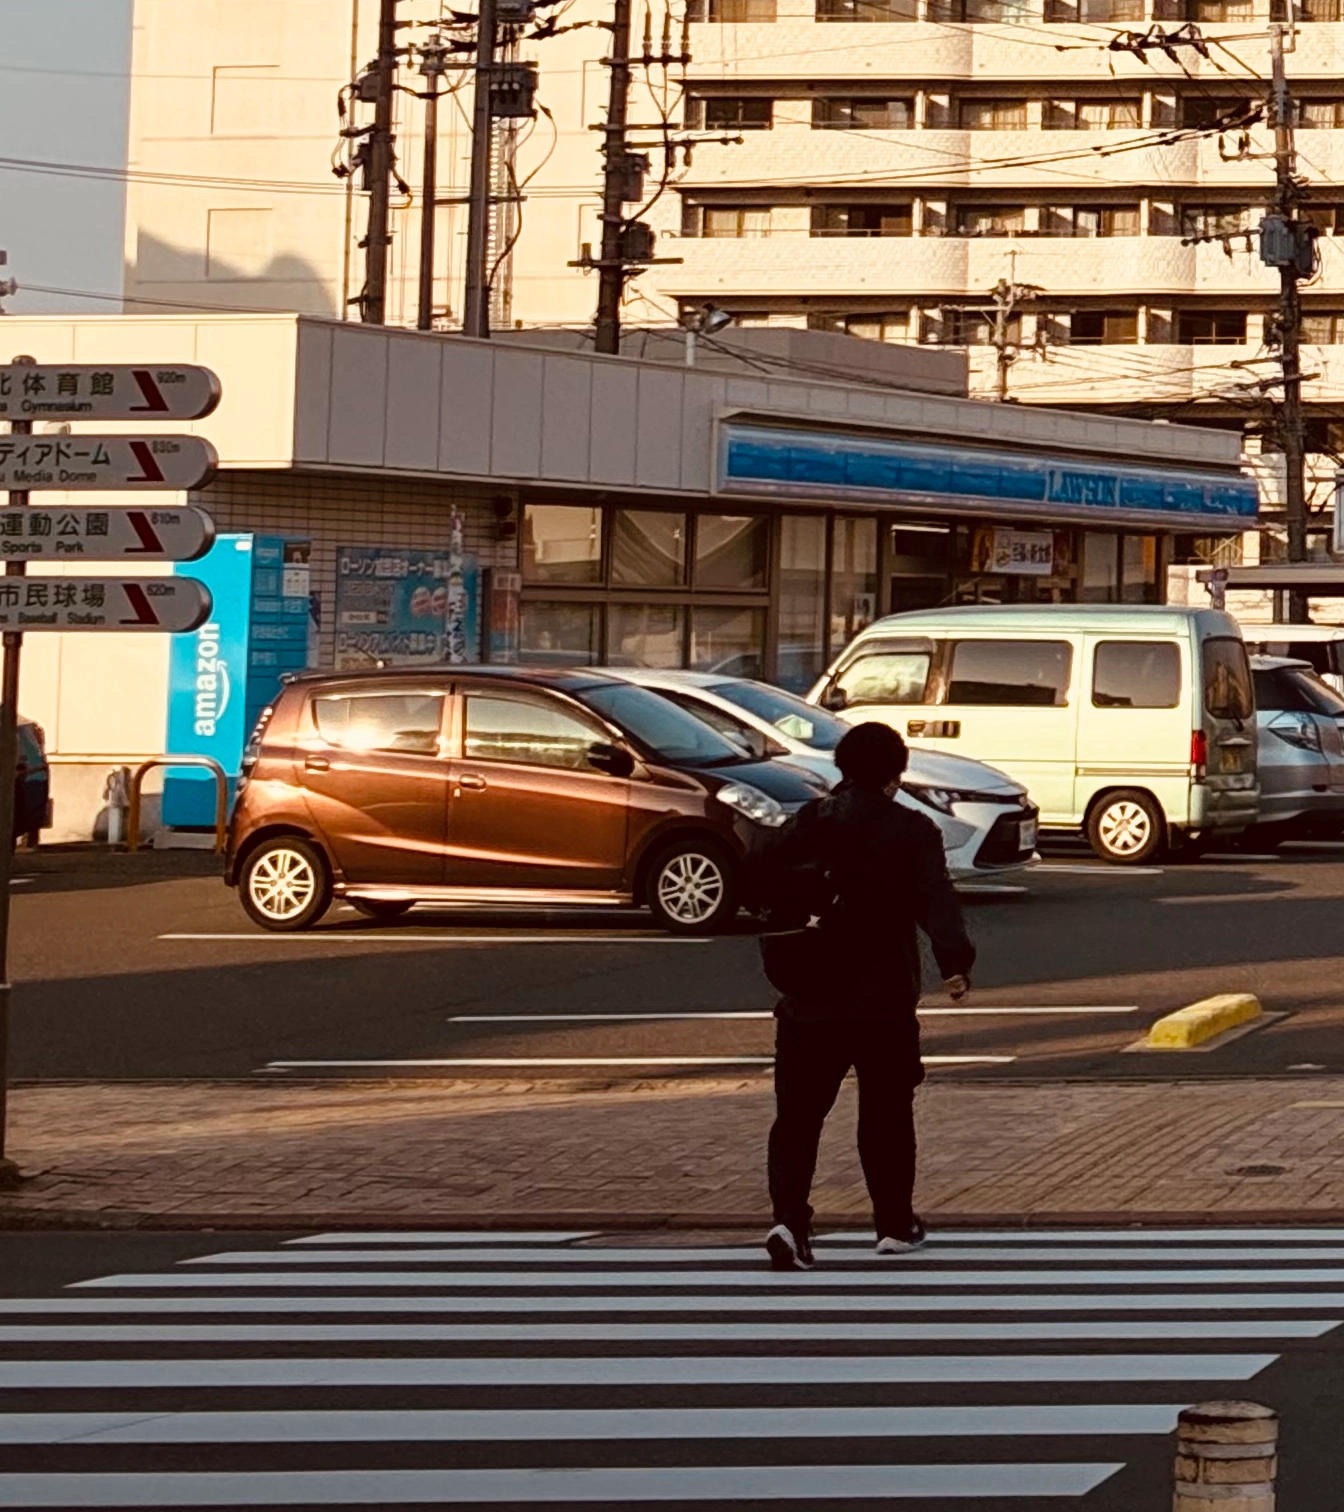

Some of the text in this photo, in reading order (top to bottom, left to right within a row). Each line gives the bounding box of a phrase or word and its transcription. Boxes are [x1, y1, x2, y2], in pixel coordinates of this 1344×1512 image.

[14, 470, 53, 483] Media
[59, 469, 97, 483] Dome
[2, 541, 84, 555] Sports Park
[194, 623, 220, 736] amazon
